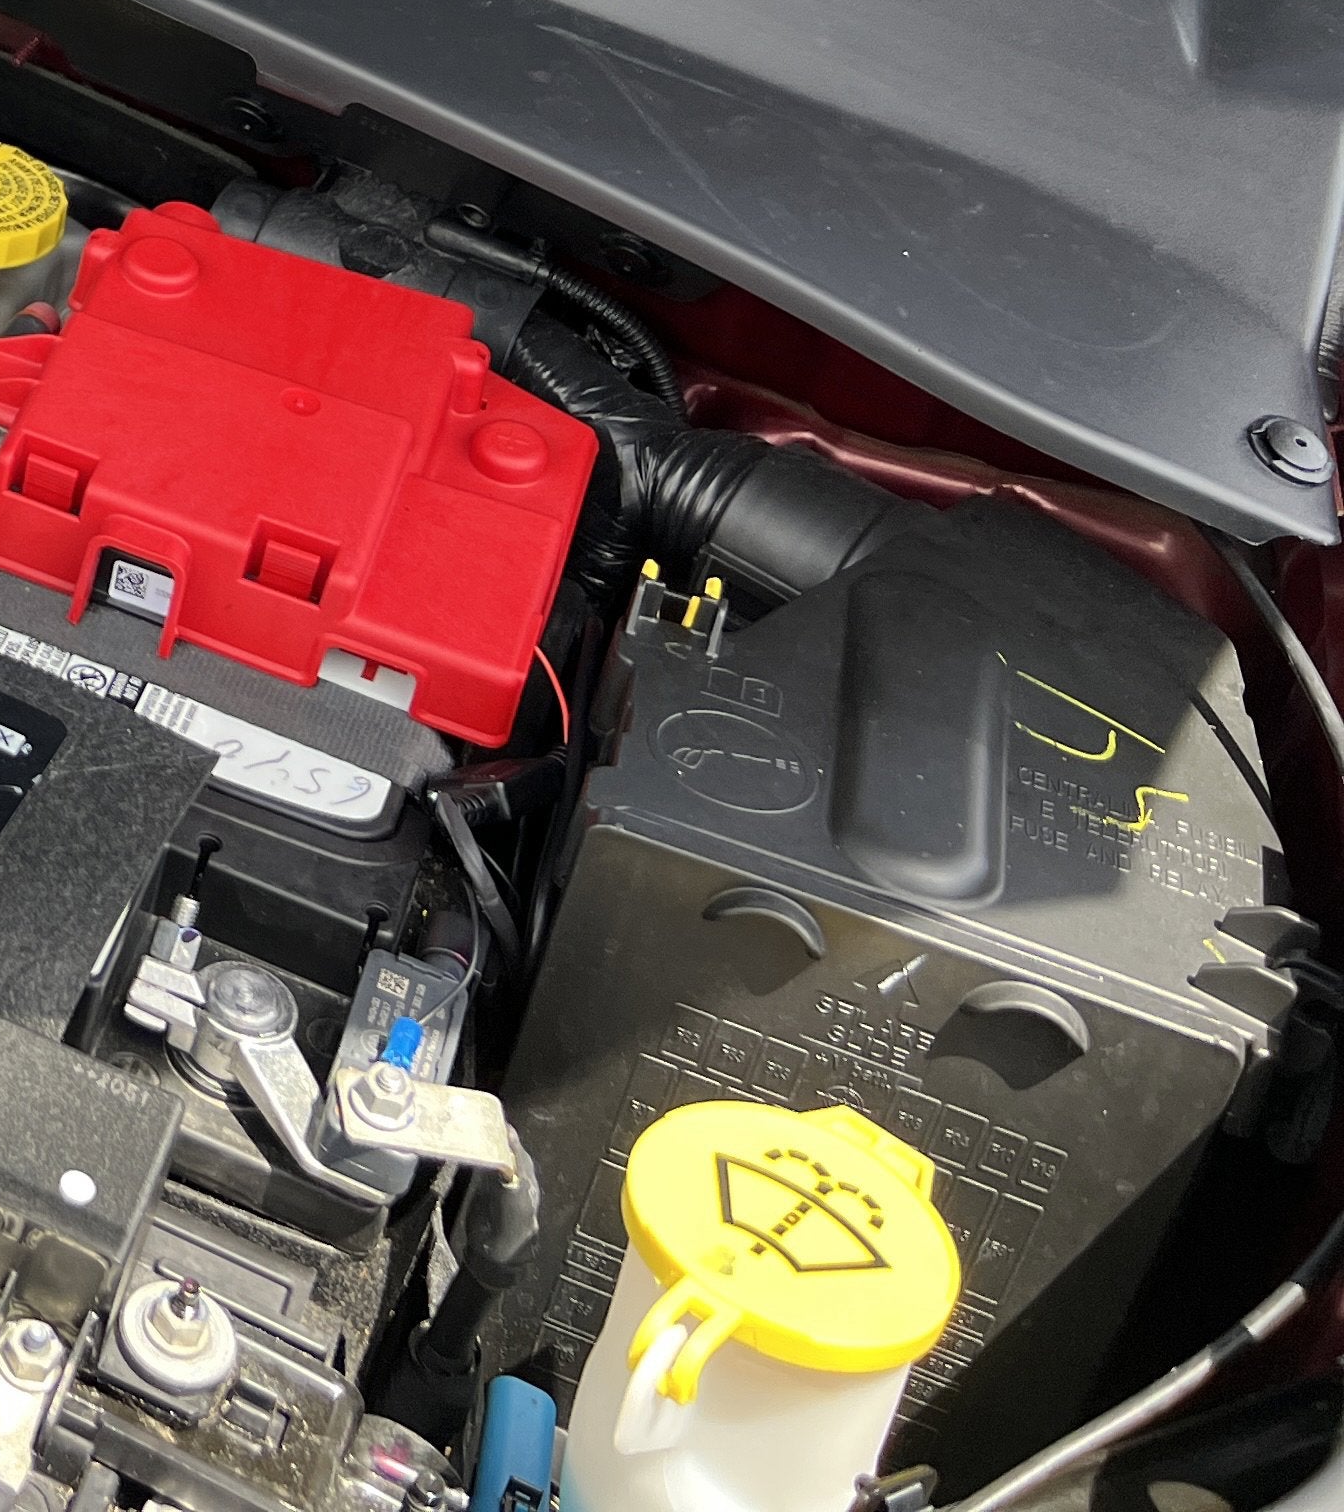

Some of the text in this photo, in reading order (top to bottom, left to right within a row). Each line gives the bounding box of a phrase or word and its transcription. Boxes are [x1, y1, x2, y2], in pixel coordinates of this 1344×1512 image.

[1016, 764, 1161, 832] CENTRALIA
[1039, 798, 1057, 821] E
[1009, 814, 1228, 911] FUSE AND RELAY
[826, 1022, 912, 1069] SLIDE
